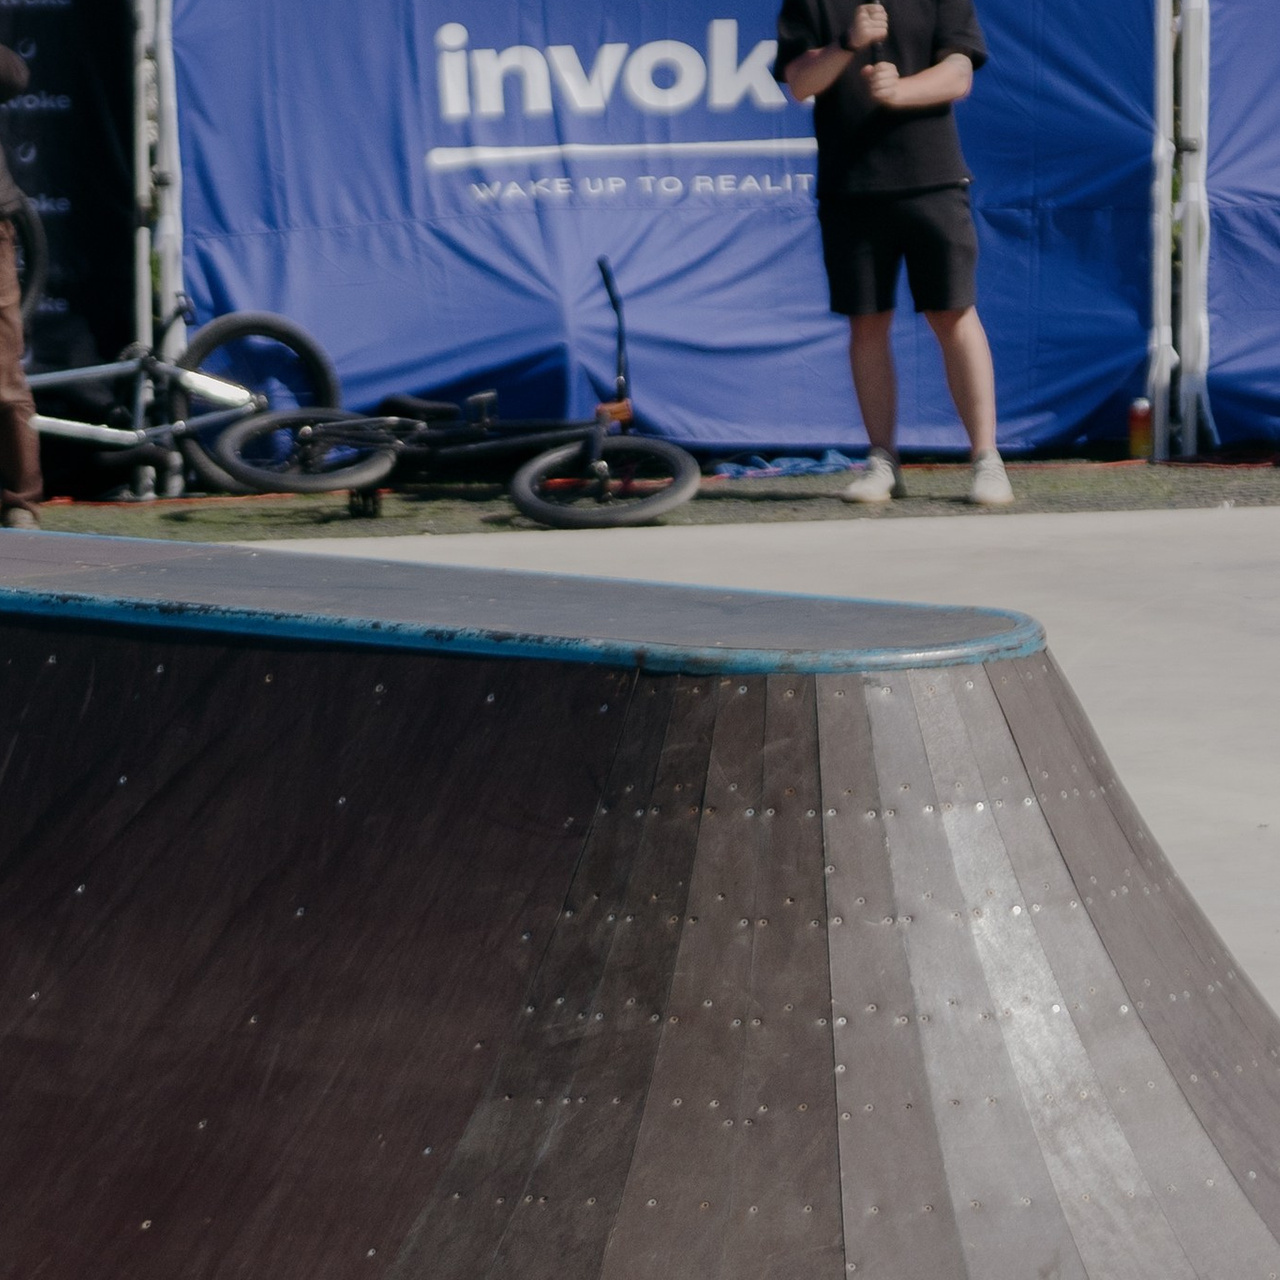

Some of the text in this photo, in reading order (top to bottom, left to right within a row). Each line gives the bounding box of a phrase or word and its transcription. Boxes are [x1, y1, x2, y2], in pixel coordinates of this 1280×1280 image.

[434, 19, 788, 121] invok
[471, 173, 815, 199] WAKE UP TO REALIT
